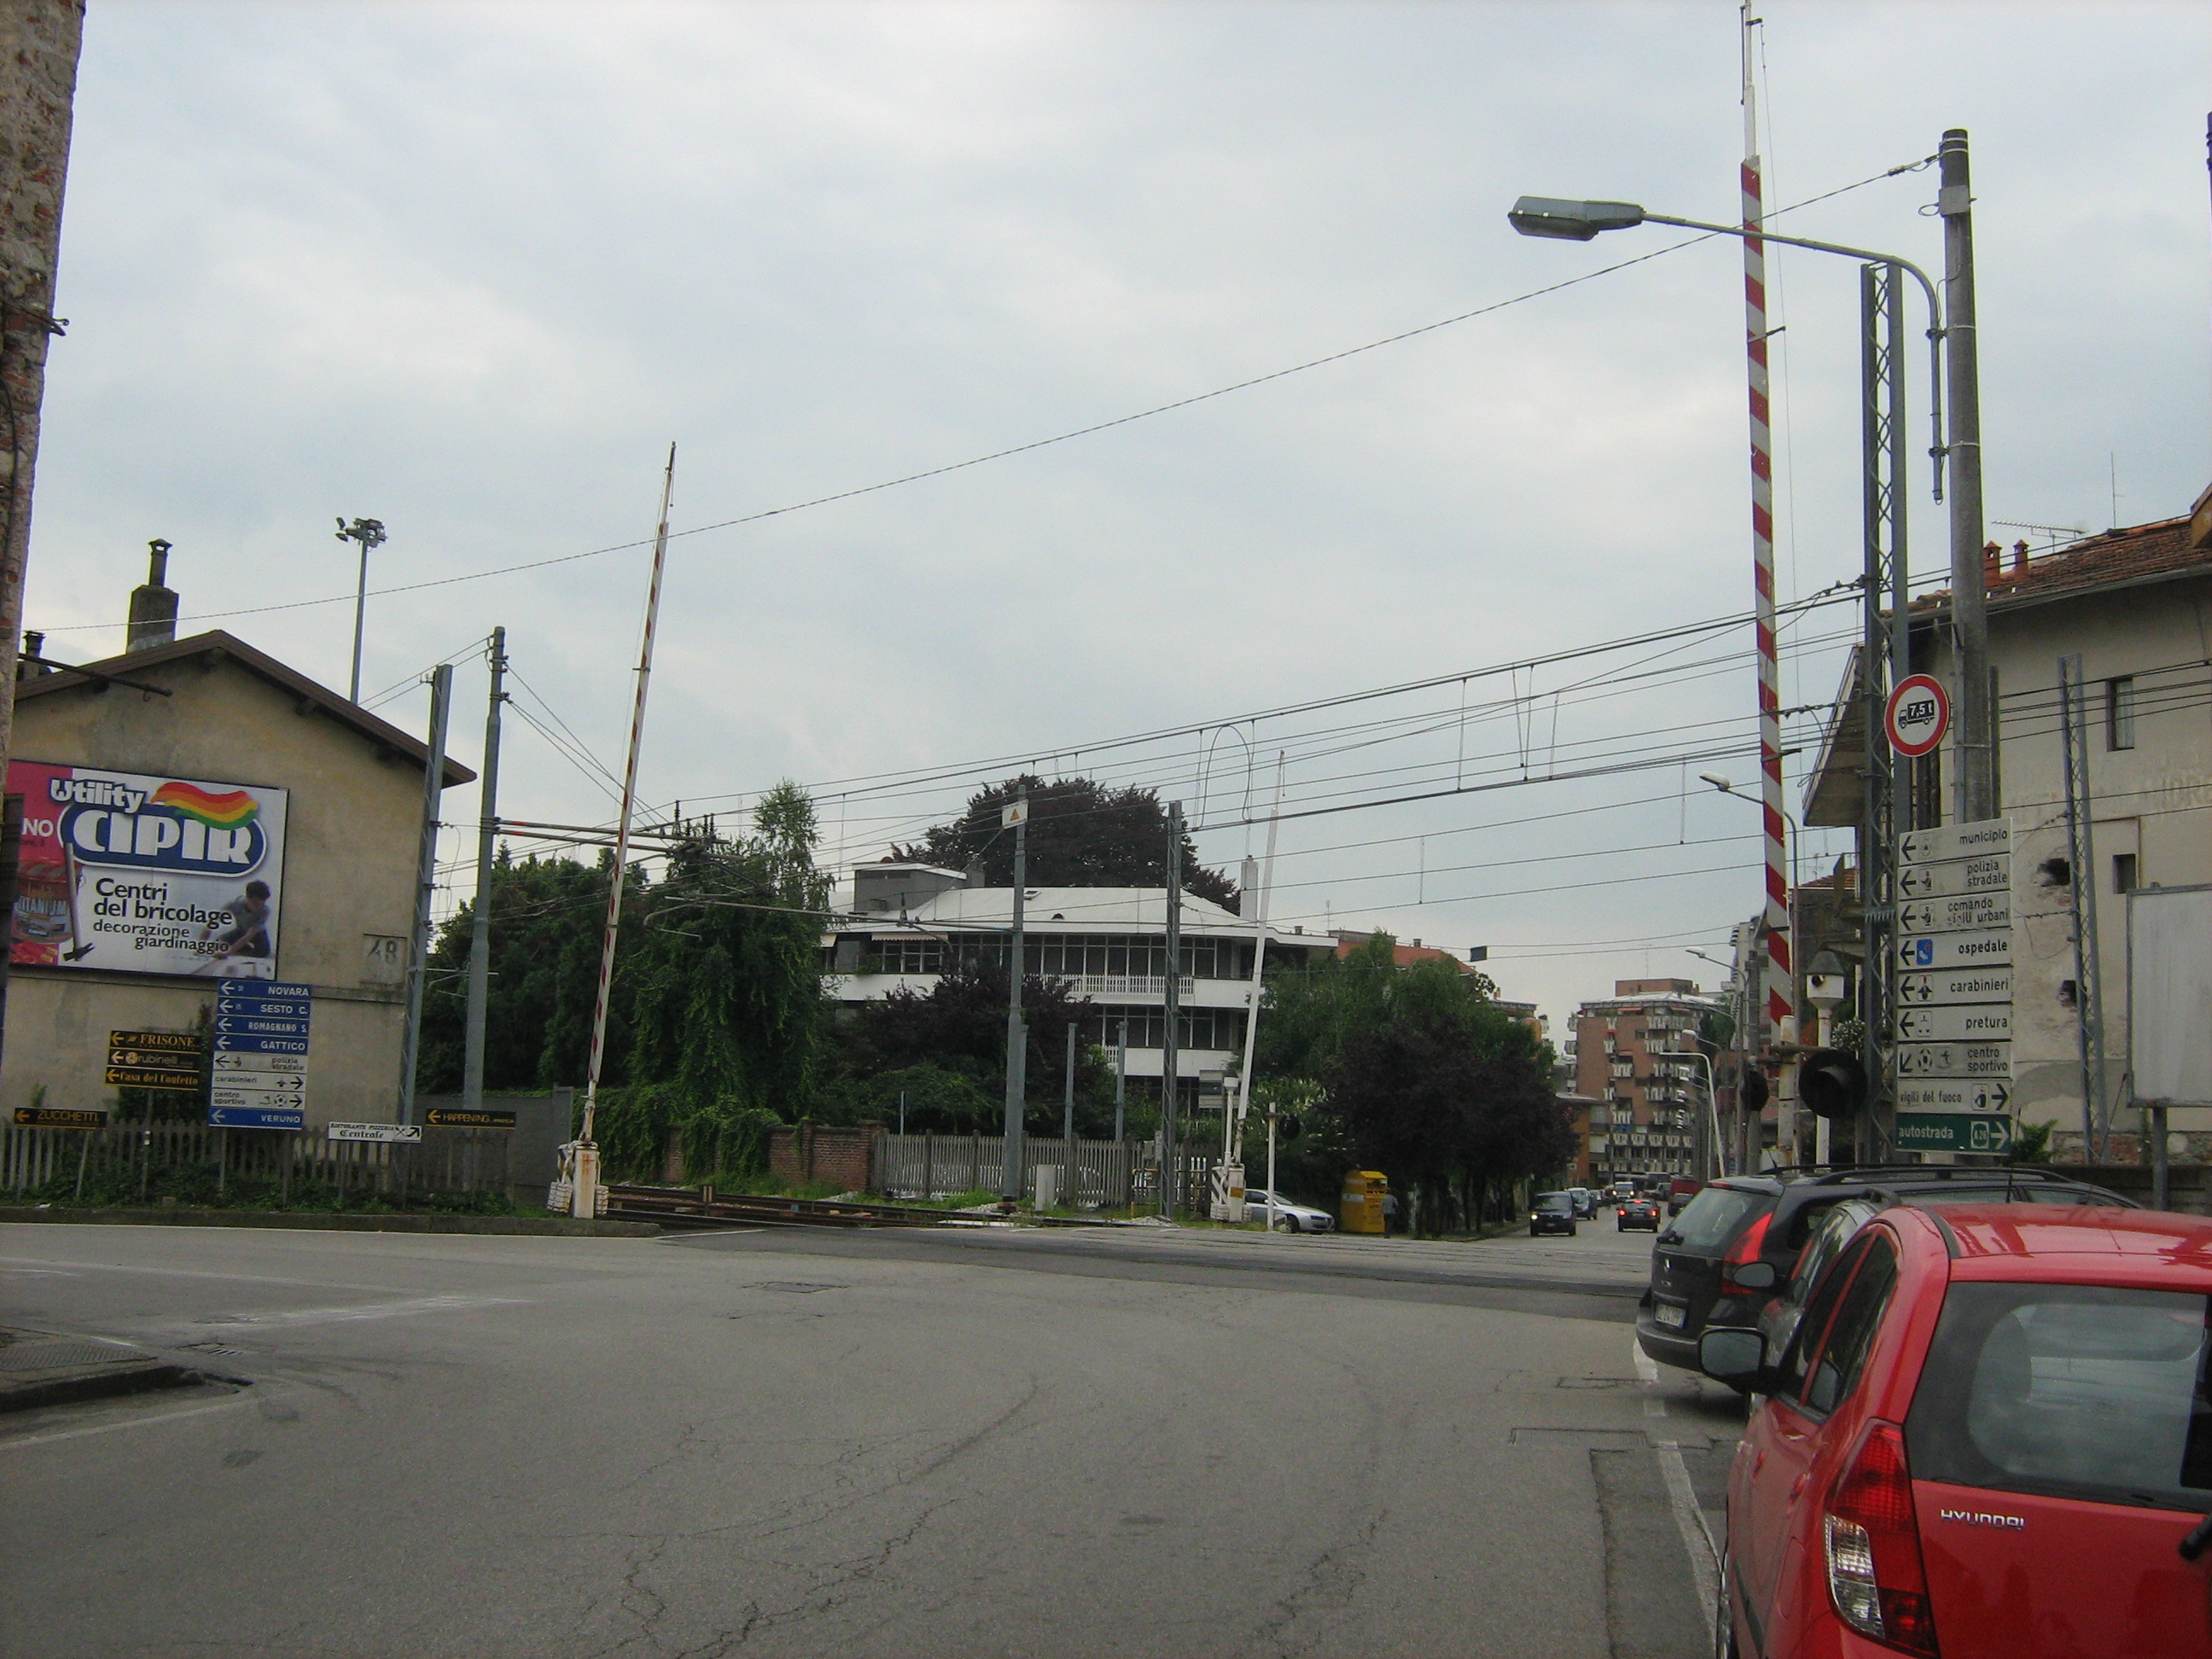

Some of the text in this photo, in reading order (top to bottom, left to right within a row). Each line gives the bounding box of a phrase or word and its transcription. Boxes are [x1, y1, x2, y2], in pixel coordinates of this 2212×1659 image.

[1909, 703, 1926, 717] 7,5
[50, 778, 144, 813] Utility
[73, 809, 251, 864] CIPIR
[1959, 830, 2007, 844] municipio
[1967, 859, 1999, 876] polizia
[1967, 874, 2007, 887] stradale
[95, 877, 168, 901] Centri
[1947, 898, 1993, 912] comando
[94, 898, 233, 930] del bricolage
[1977, 908, 2008, 923] urbani
[93, 919, 190, 938] decorazione
[135, 934, 230, 954] giardinaggio
[1958, 939, 2008, 956] ospedale
[1950, 977, 2009, 992] carabinieri
[268, 987, 309, 997] NOVARA
[260, 1004, 294, 1014] SESTO
[247, 1022, 297, 1032] ROMAGNANO
[1965, 1016, 2008, 1030] pretura
[140, 1033, 195, 1047] FRISONE
[260, 1040, 306, 1051] GATTICO
[1967, 1046, 2000, 1058] centro
[1967, 1059, 2008, 1073] sportivo
[214, 1097, 247, 1106] sportivo
[1900, 1090, 1962, 1104] vigili del fuoco
[260, 1115, 300, 1124] VERUNO
[339, 1129, 384, 1139] Centrale
[1898, 1126, 1954, 1139] autostrada
[1941, 1509, 2025, 1528] HYUNDAI
